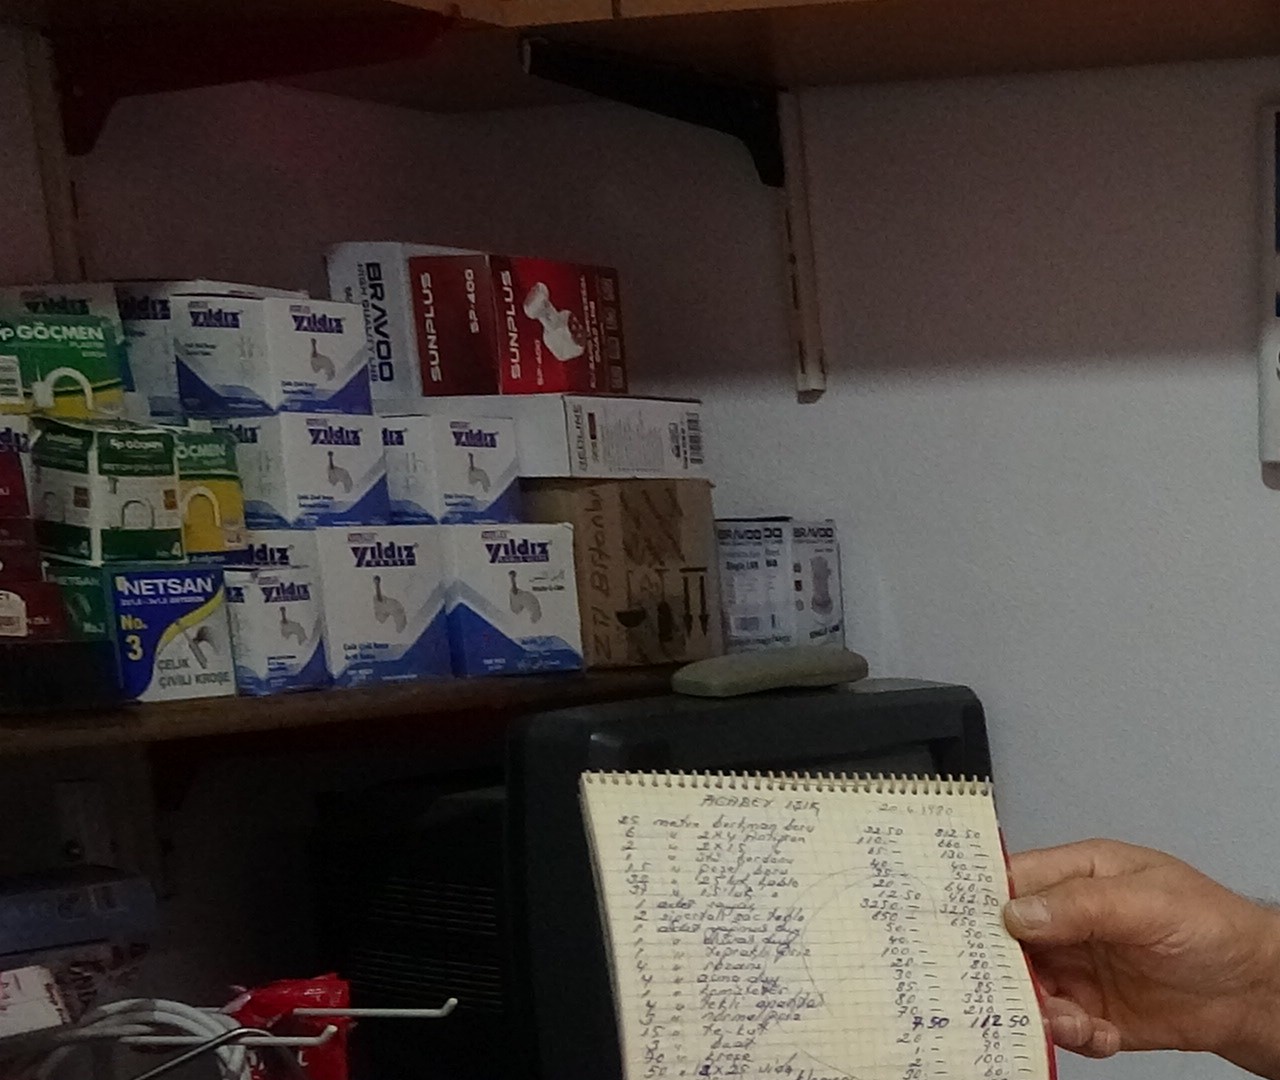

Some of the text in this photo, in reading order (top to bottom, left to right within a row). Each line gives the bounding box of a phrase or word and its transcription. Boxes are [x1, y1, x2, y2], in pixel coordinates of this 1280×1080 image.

[15, 320, 105, 343] GÖÇMEN
[419, 271, 443, 383] SUNPLUS
[500, 269, 522, 380] SUNPLUS
[351, 541, 417, 568] yıldız
[484, 538, 550, 564] yıldız
[121, 576, 214, 597] NETSAN
[124, 633, 145, 662] 3
